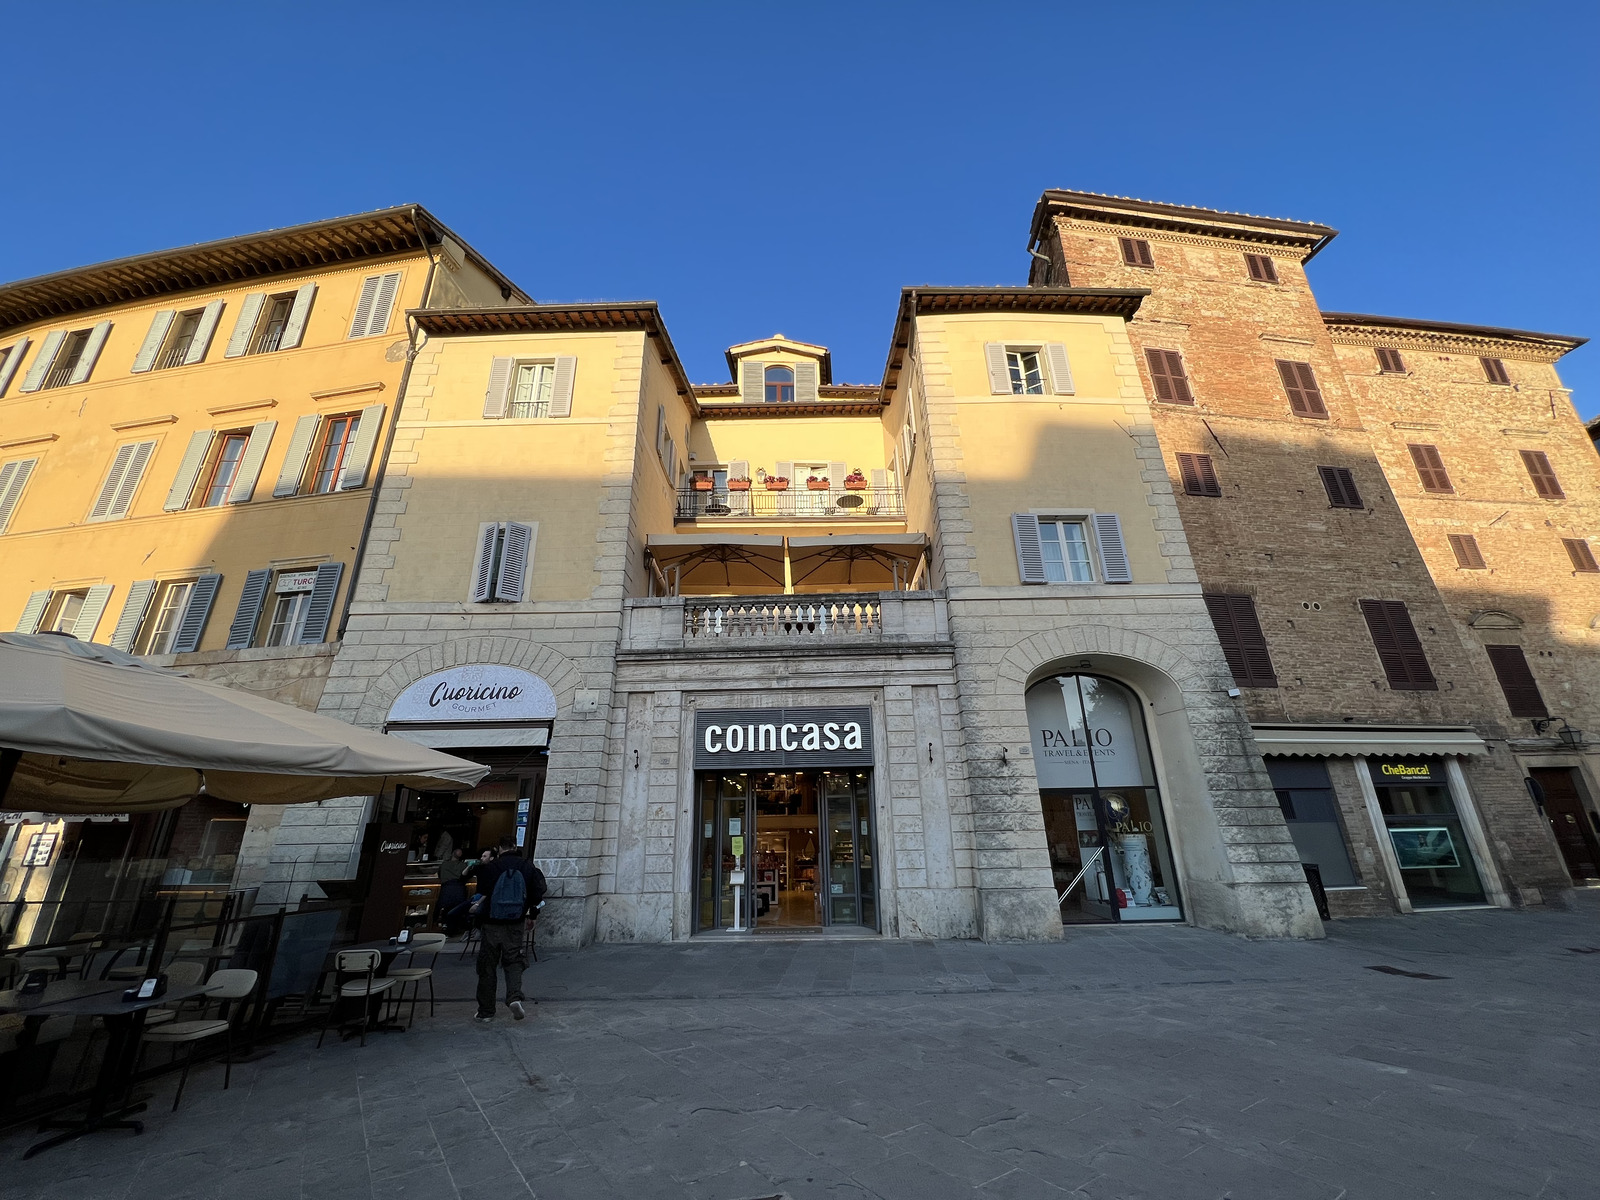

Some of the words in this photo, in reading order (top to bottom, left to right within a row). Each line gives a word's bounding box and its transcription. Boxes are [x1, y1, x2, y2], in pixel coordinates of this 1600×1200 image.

[429, 681, 523, 707] Cuoricino
[452, 702, 496, 713] GOURMET
[705, 722, 862, 753] coincasa
[1041, 728, 1113, 747] PALIO
[1043, 749, 1116, 757] TRAVEL&EENTS
[1381, 764, 1430, 775] CheBanca!
[1115, 819, 1153, 832] PALIO
